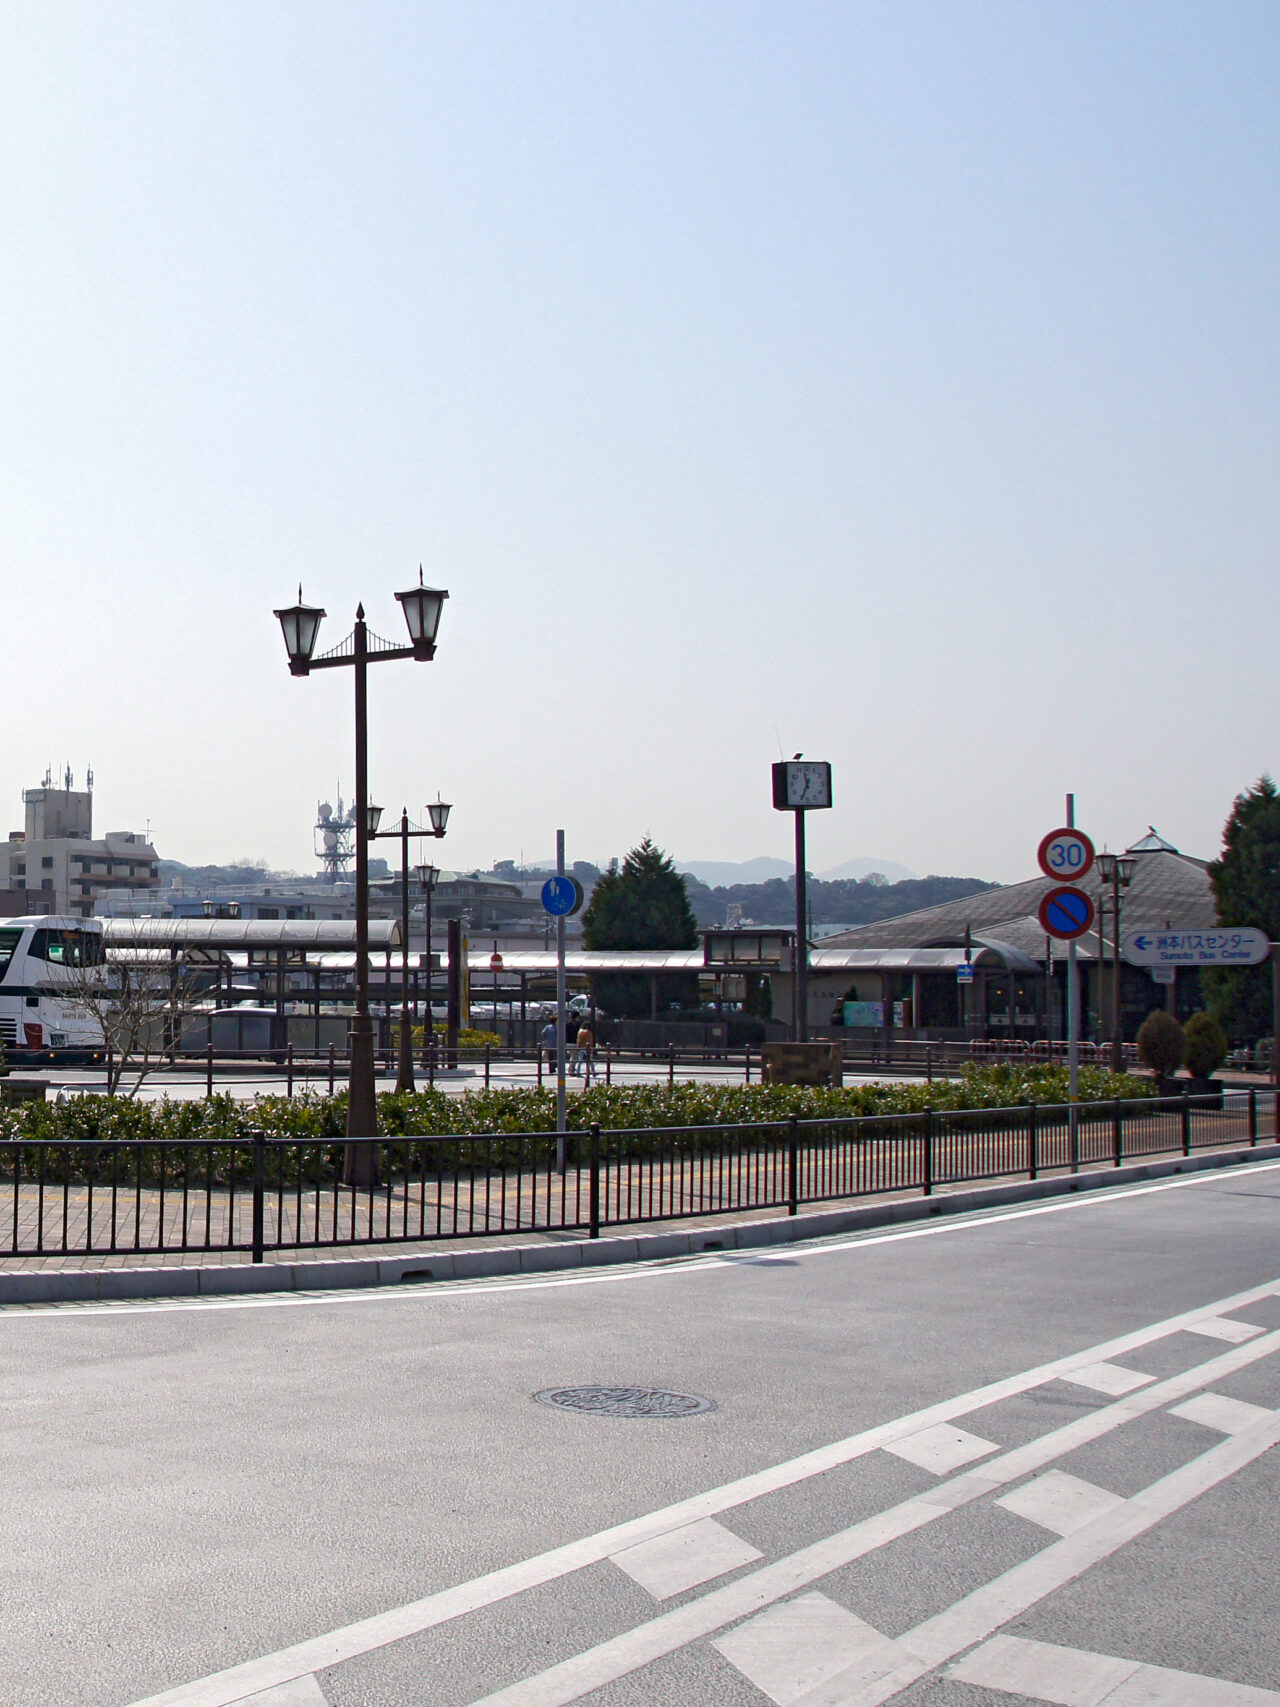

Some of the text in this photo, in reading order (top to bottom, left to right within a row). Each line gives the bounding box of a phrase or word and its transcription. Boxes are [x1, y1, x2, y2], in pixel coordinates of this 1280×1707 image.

[1051, 843, 1083, 867] 30
[1156, 934, 1256, 950] 洲本バスセンター
[1160, 949, 1252, 960] Sumoto Bus Center
